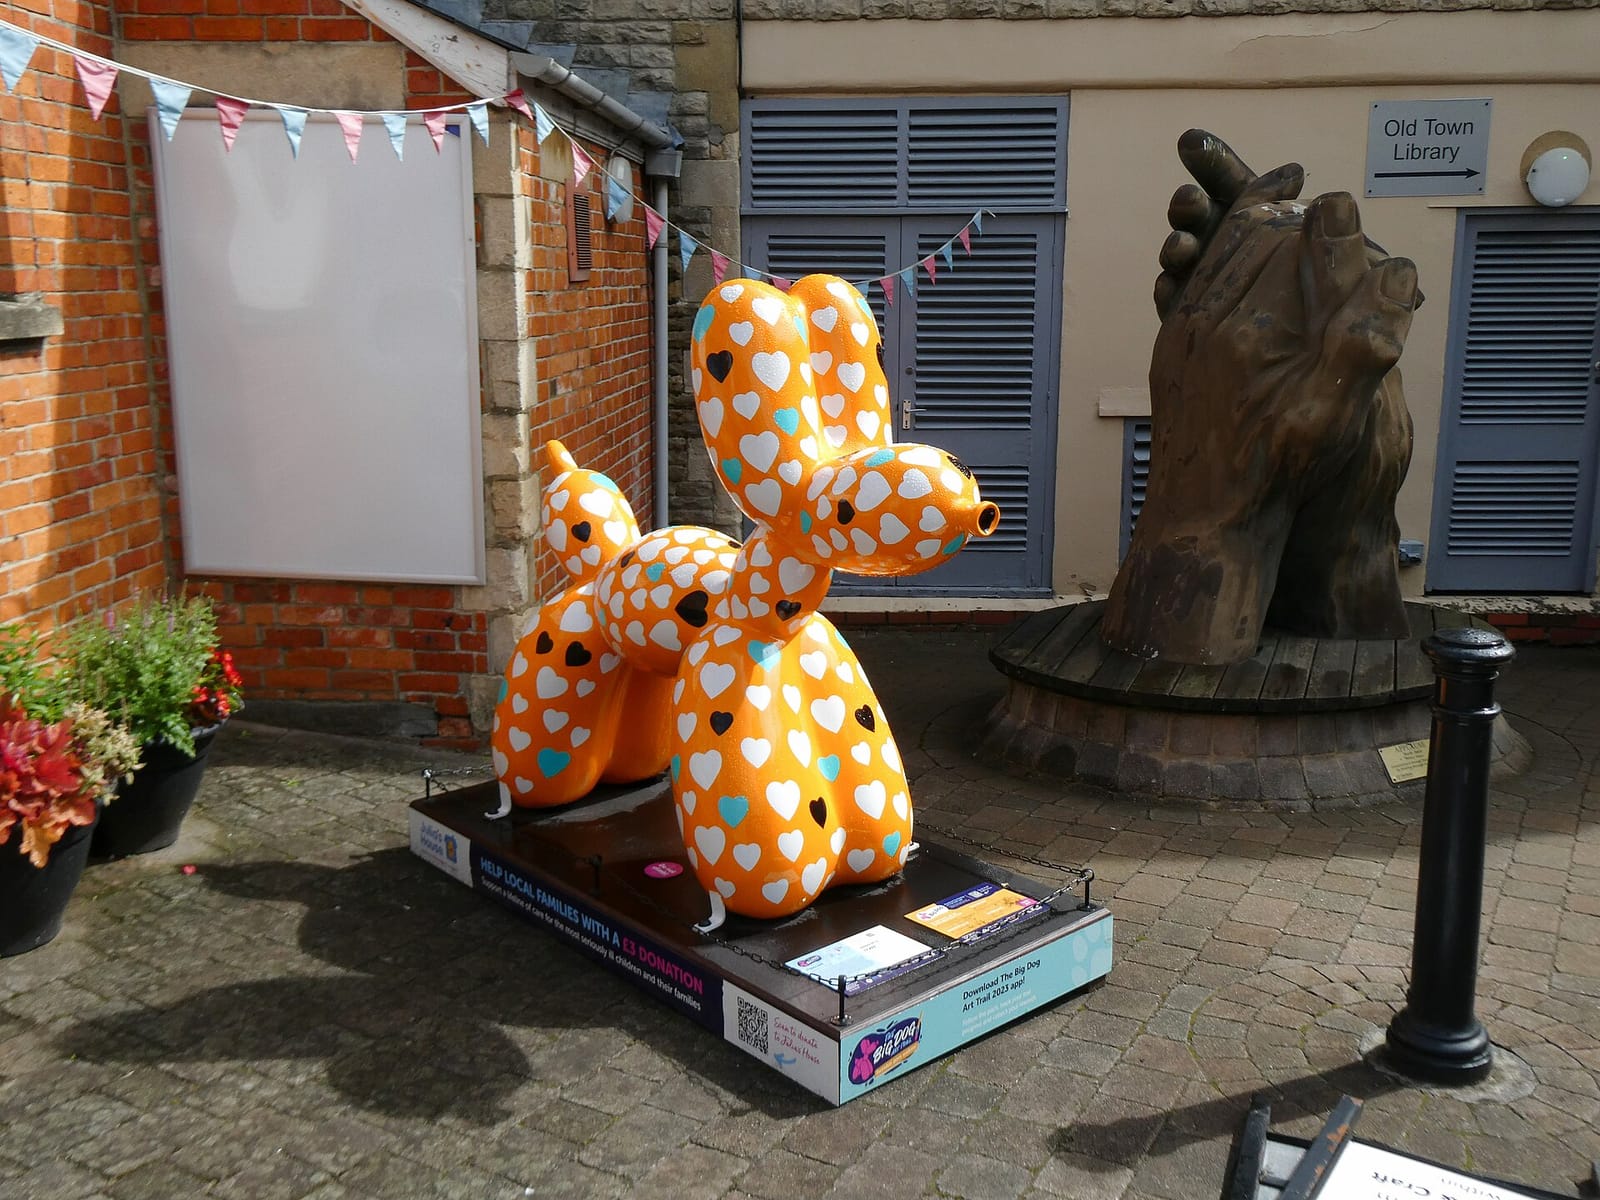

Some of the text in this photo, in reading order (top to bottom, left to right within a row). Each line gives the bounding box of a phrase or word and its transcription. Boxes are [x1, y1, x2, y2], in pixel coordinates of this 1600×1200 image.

[1384, 118, 1474, 137] Old Town
[1393, 143, 1460, 164] Library
[480, 856, 503, 879] HELP
[504, 870, 535, 899] LOCAL
[536, 887, 579, 924] FAMILIES
[580, 912, 610, 942] WITH
[612, 930, 620, 948] A
[622, 935, 636, 957] £3
[639, 945, 705, 996] DONATION
[532, 906, 544, 920] care
[544, 912, 554, 924] for
[554, 918, 564, 931] the
[565, 925, 581, 940] most
[580, 935, 608, 959] seriously
[615, 954, 642, 976] children
[642, 970, 656, 984] and
[656, 977, 673, 994] their
[674, 986, 702, 1012] families
[962, 1002, 974, 1013] Art
[976, 992, 991, 1006] Trail
[992, 983, 1009, 998] 2023
[1010, 976, 1025, 990] app!
[963, 976, 999, 1000] Download
[1000, 972, 1013, 983] The
[1014, 965, 1025, 977] Big
[1027, 959, 1041, 971] Dog
[797, 1029, 818, 1049] donate
[873, 1040, 893, 1064] BIG
[894, 1021, 916, 1047] DOG
[801, 1047, 820, 1065] House
[1371, 1171, 1431, 1196] Craft
